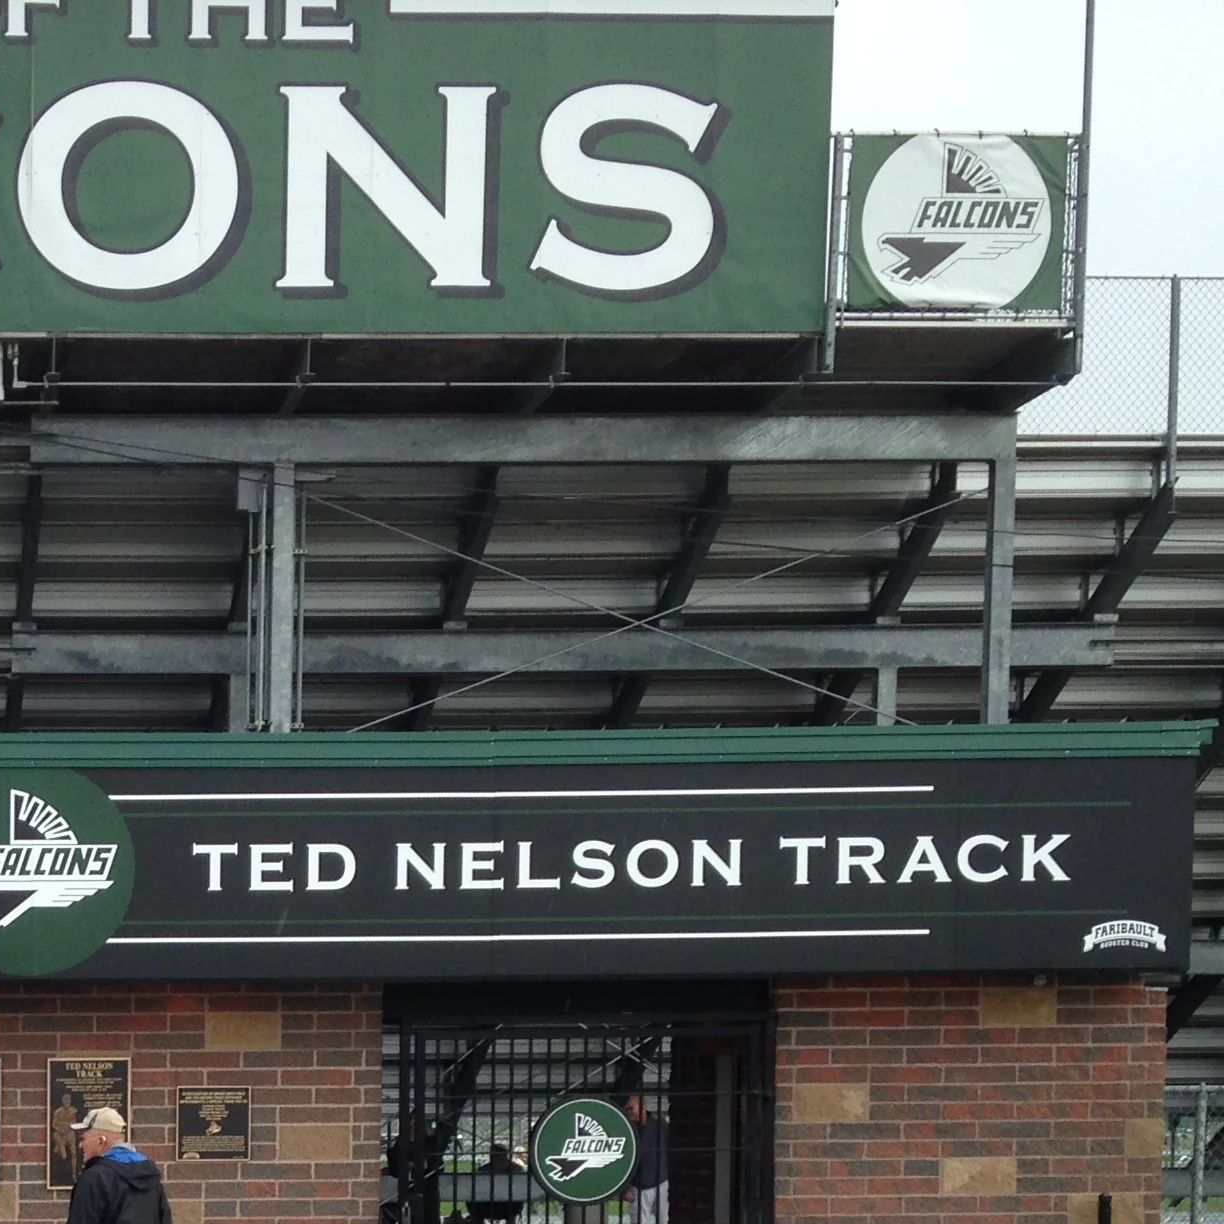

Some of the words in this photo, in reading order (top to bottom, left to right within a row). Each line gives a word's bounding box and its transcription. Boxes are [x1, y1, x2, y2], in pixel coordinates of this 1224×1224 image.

[917, 201, 1039, 229] FALCONS
[192, 842, 356, 891] TED
[395, 838, 743, 890] NELSON
[779, 833, 1072, 886] TRACK
[1095, 923, 1155, 938] FARIBAULT
[65, 1062, 81, 1070] TED
[83, 1062, 113, 1070] NELSON
[564, 1139, 623, 1153] FALCONS
